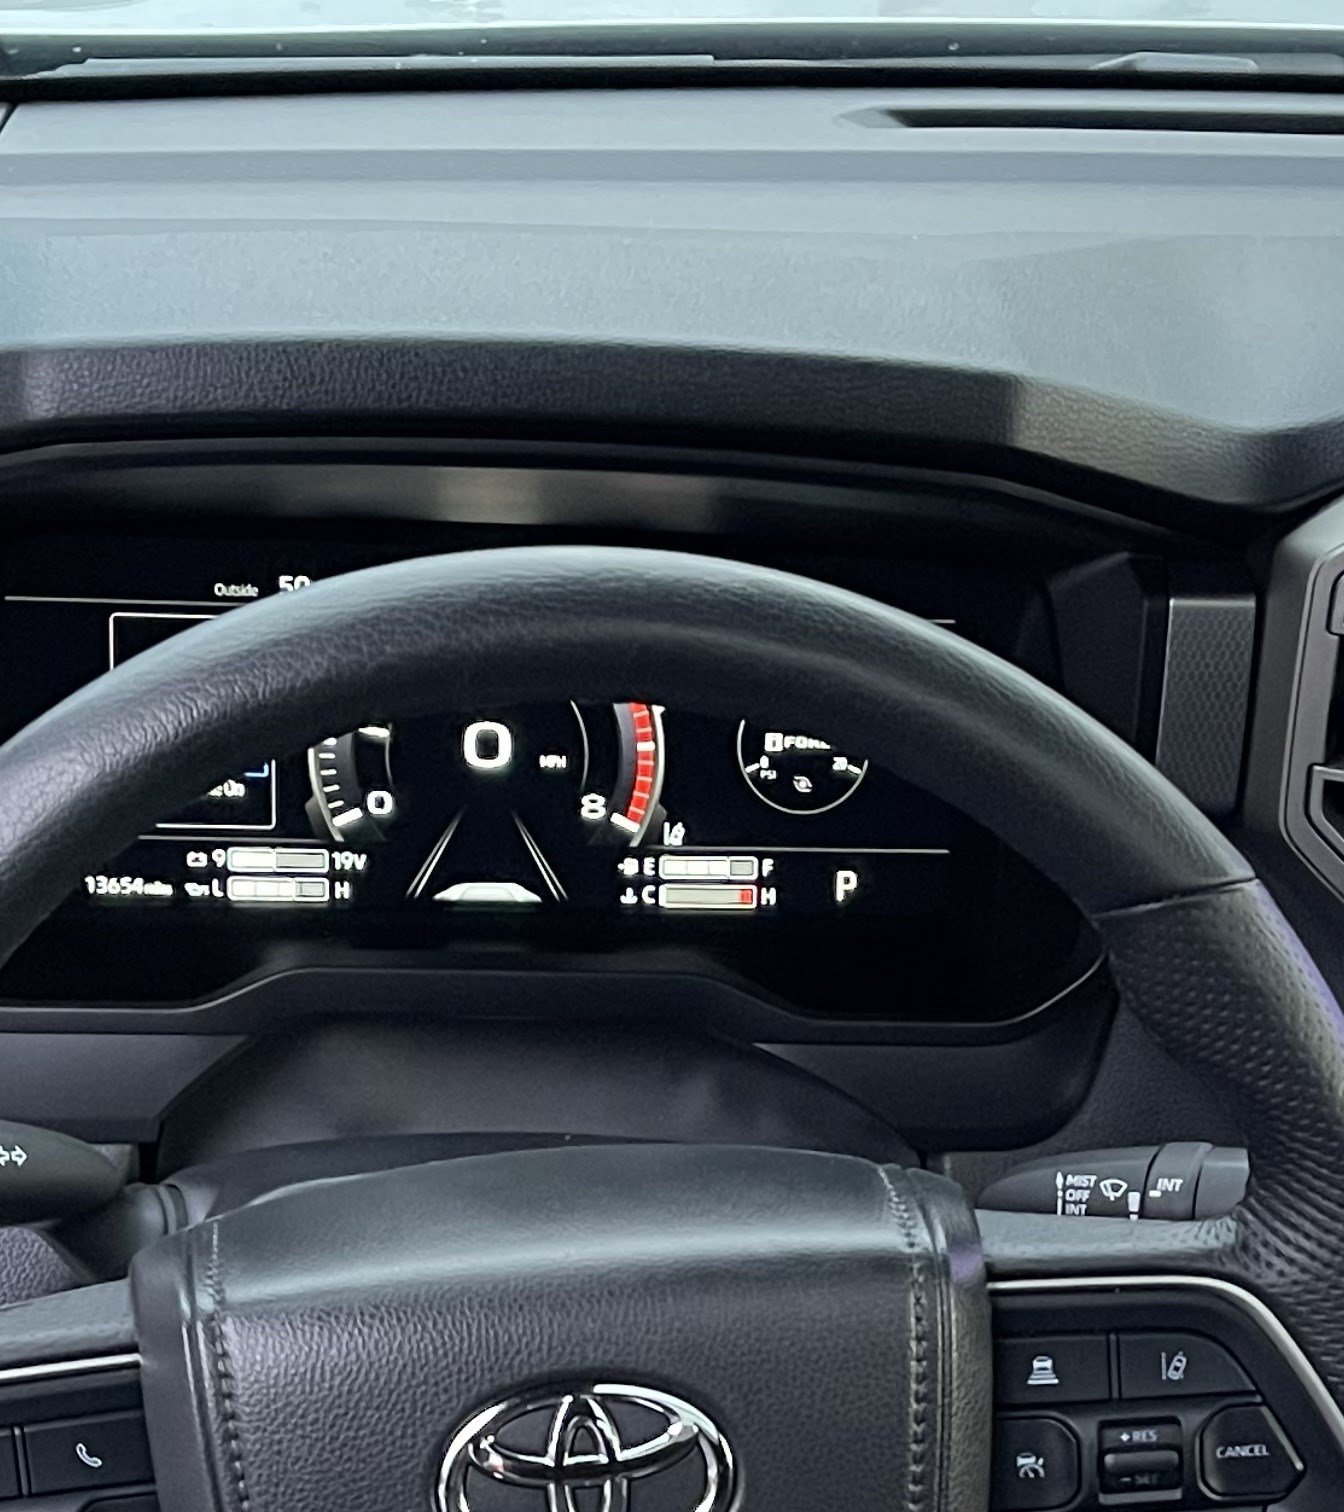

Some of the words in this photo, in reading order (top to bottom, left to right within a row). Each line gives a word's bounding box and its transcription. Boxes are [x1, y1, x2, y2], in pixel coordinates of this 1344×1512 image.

[214, 583, 258, 596] Outside
[464, 721, 512, 770] 0
[367, 791, 393, 817] 0
[581, 793, 606, 820] 8
[212, 849, 226, 867] 9
[332, 851, 367, 871] 19V
[643, 857, 655, 876] E
[762, 859, 773, 877] F
[212, 879, 224, 897] L
[335, 881, 350, 899] H
[642, 885, 655, 904] C
[836, 871, 857, 901] P
[761, 888, 776, 905] H
[1066, 1175, 1097, 1187] MIST
[1157, 1178, 1183, 1191] INT
[1066, 1189, 1090, 1202] OFF
[1066, 1204, 1088, 1216] INT
[1216, 1444, 1268, 1458] CANCEL
